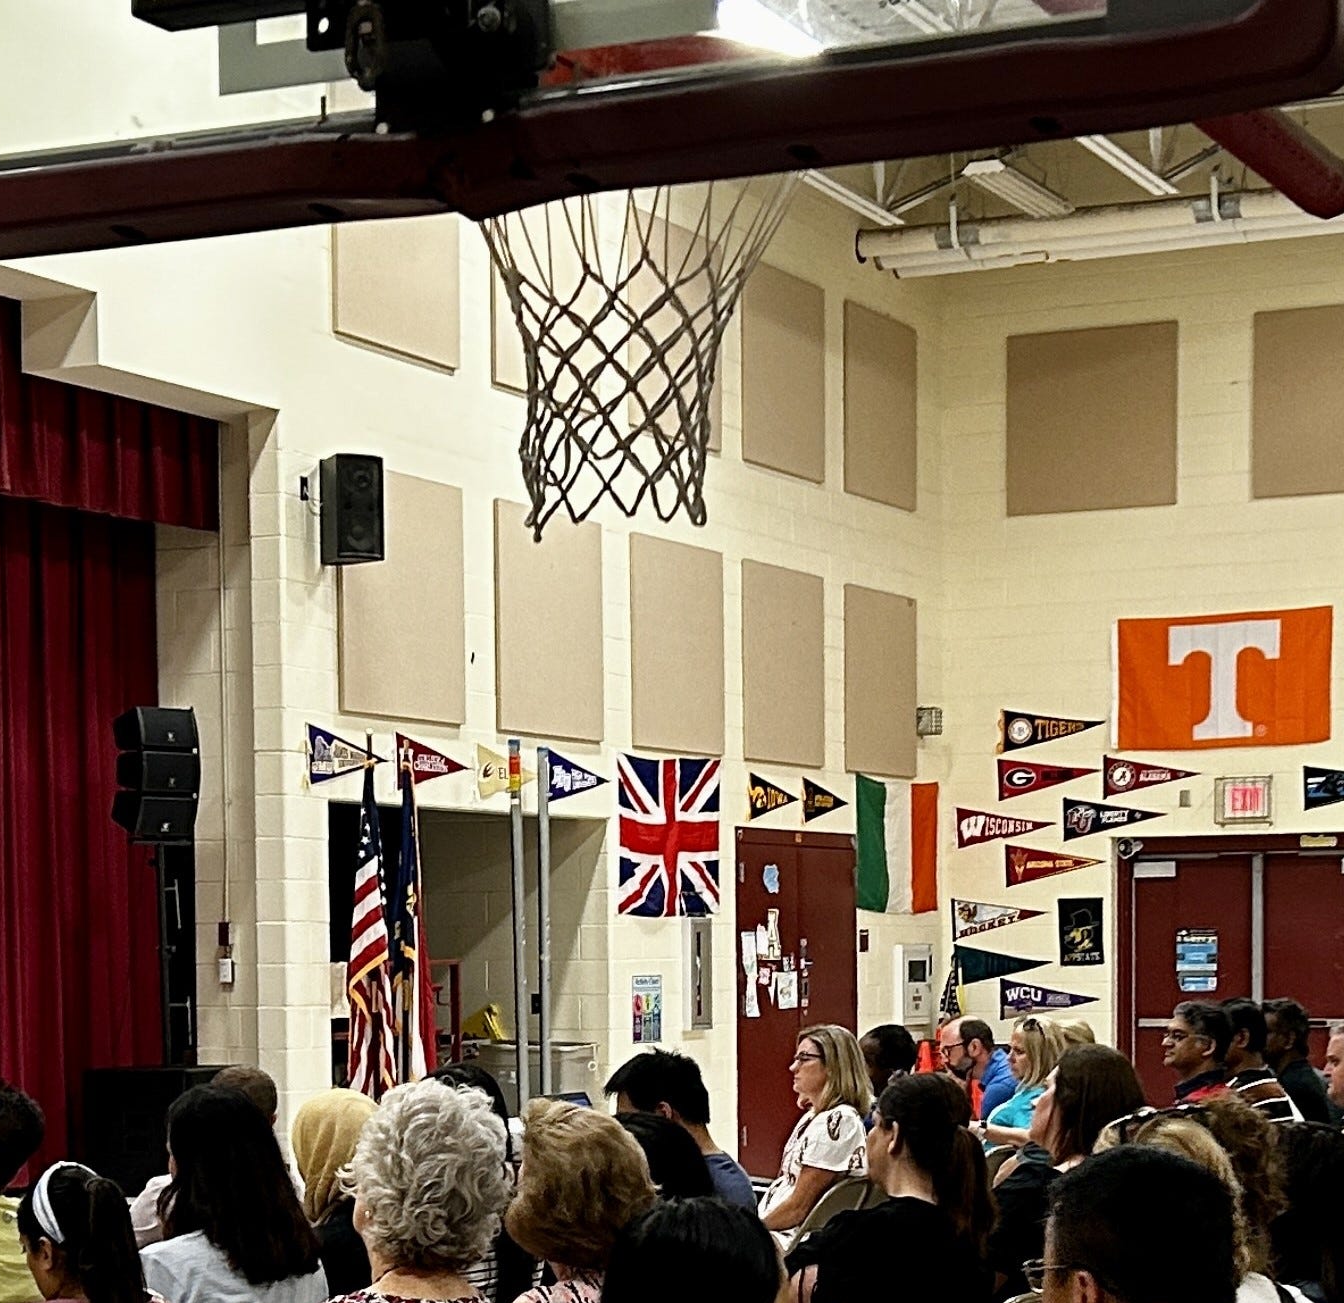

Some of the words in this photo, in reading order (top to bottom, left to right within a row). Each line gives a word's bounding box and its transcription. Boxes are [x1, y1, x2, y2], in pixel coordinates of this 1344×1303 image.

[1168, 618, 1282, 741] T
[1035, 718, 1085, 740] TIGERS
[960, 815, 1034, 843] WISCONSIN
[1005, 986, 1043, 1002] WCU
